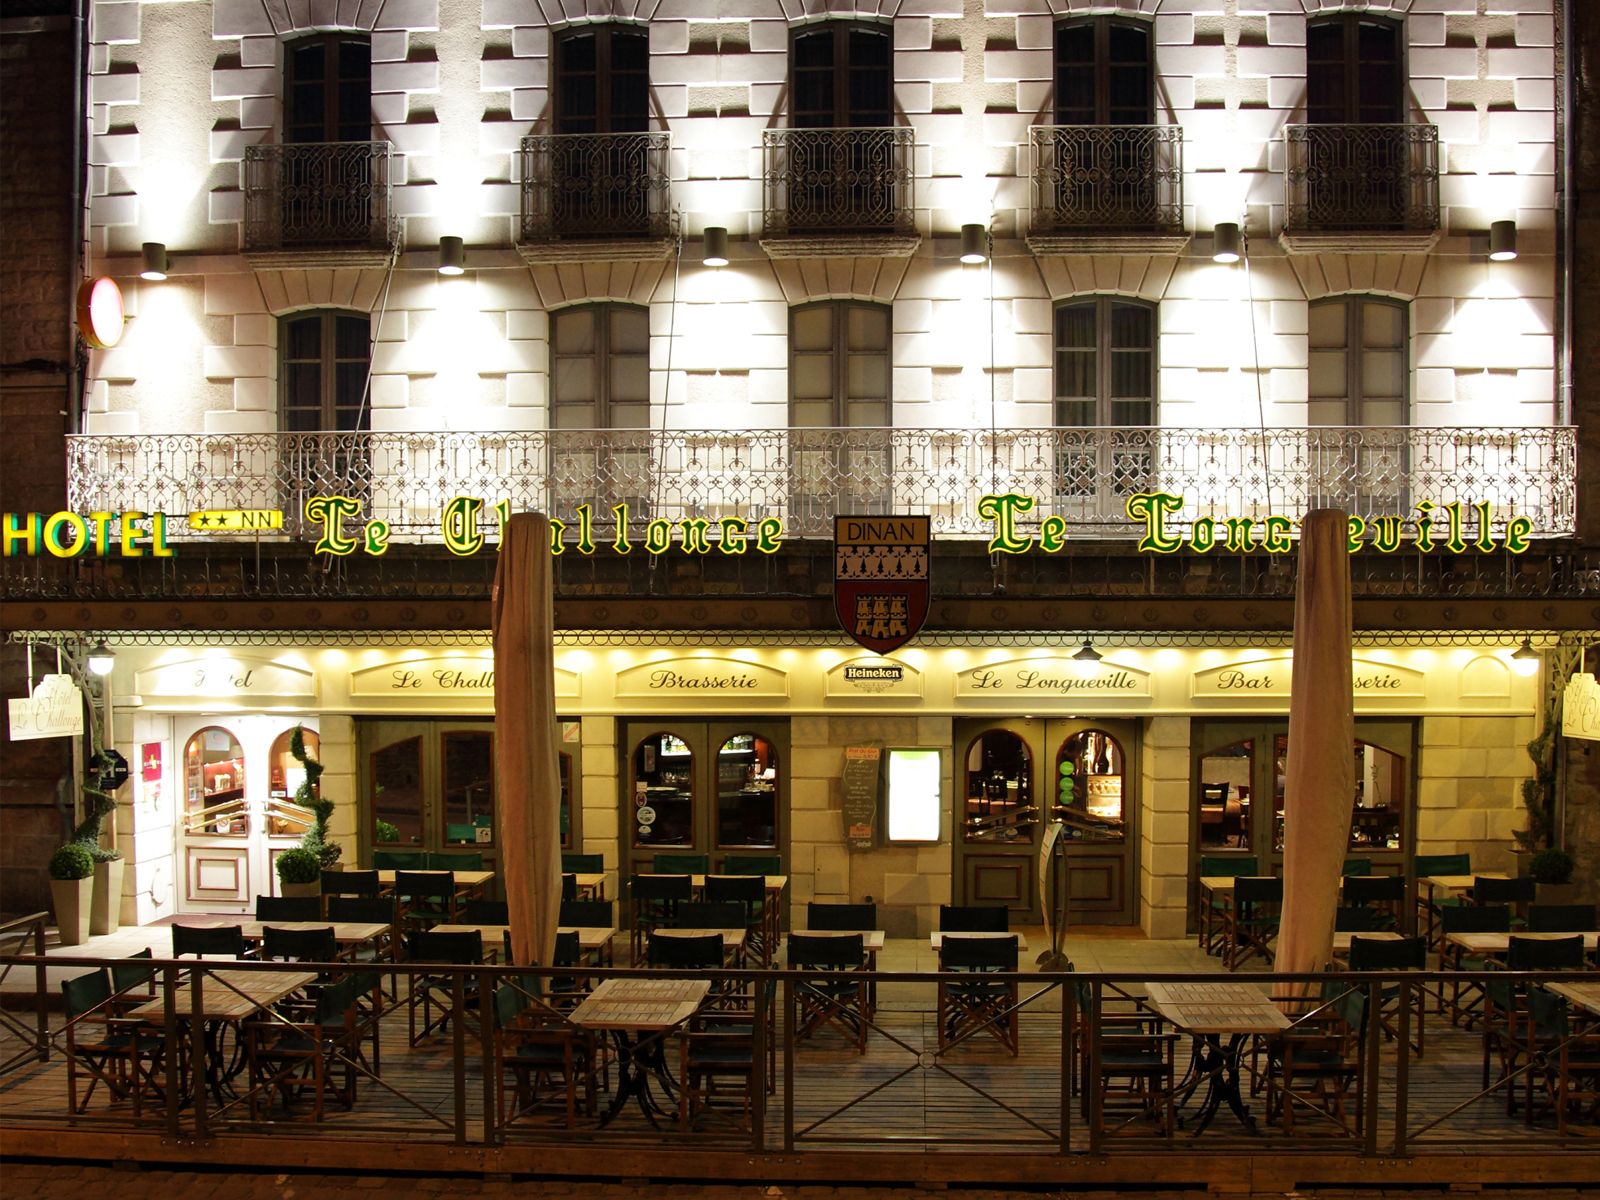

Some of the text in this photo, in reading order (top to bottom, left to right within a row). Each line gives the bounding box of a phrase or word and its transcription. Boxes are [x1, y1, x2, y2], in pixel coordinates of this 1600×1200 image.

[241, 512, 272, 527] NN
[305, 495, 390, 556] Le
[977, 491, 1534, 554] Le Longeville
[3, 511, 176, 557] HOTEL
[847, 522, 915, 541] DINAN
[392, 670, 422, 688] Le
[649, 670, 760, 688] Brasserie
[848, 668, 900, 678] Heineken
[972, 670, 1137, 694] Le Longueville
[1217, 670, 1274, 689] Bar
